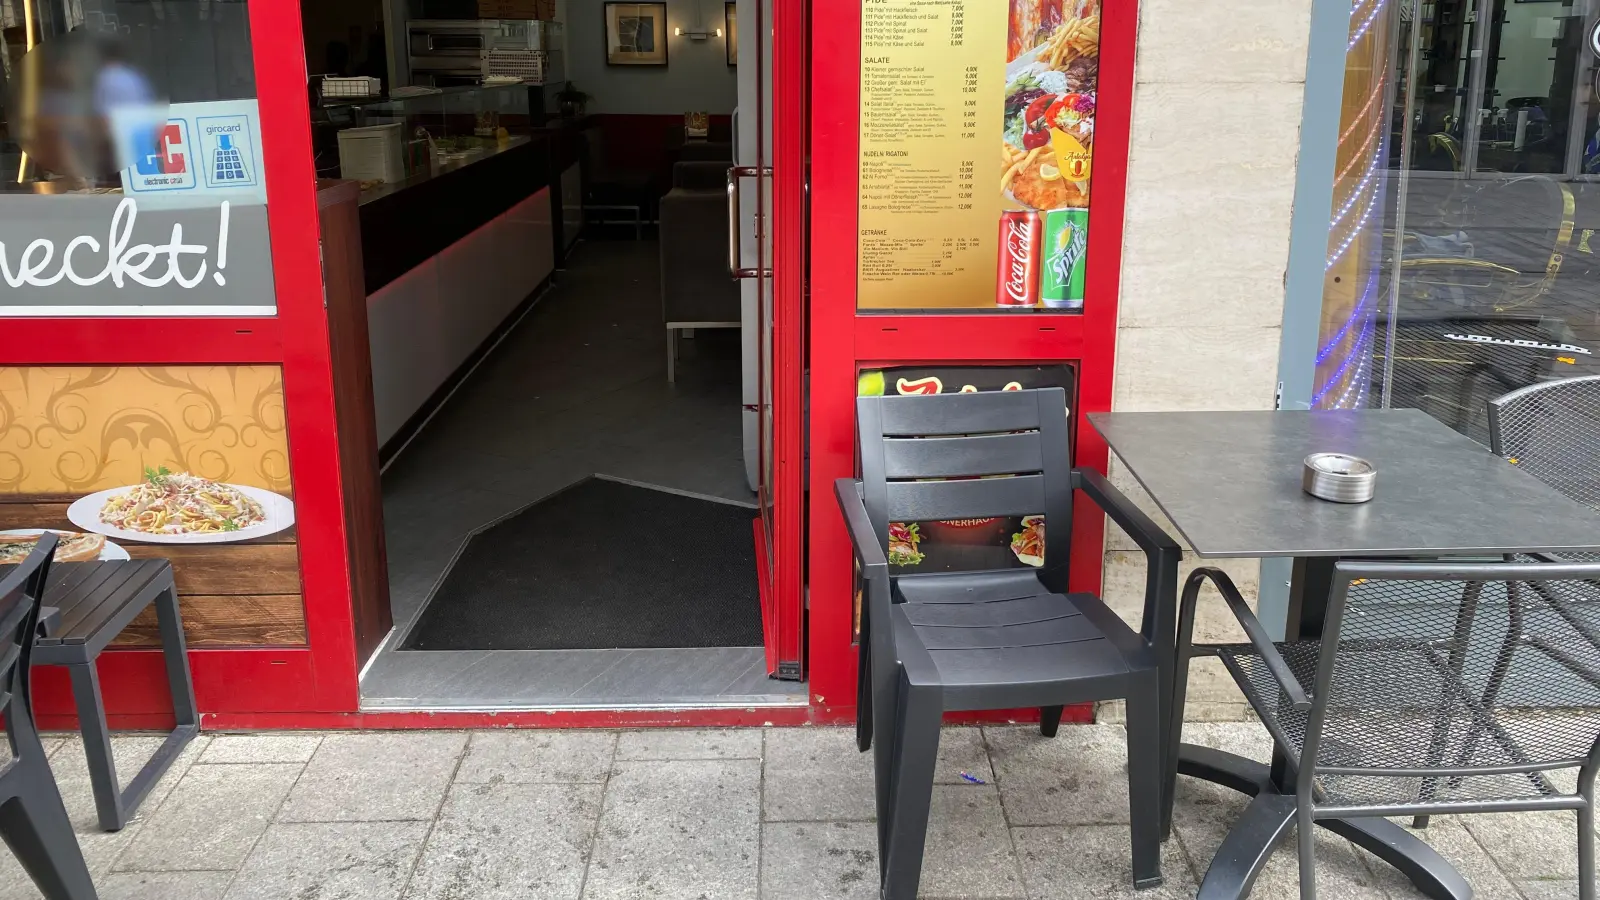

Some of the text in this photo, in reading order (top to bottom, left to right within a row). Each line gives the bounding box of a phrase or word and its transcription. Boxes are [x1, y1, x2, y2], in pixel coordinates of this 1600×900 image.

[206, 124, 240, 136] girocard
[1006, 217, 1030, 301] Coca-Cola
[1052, 228, 1086, 284] Sprite
